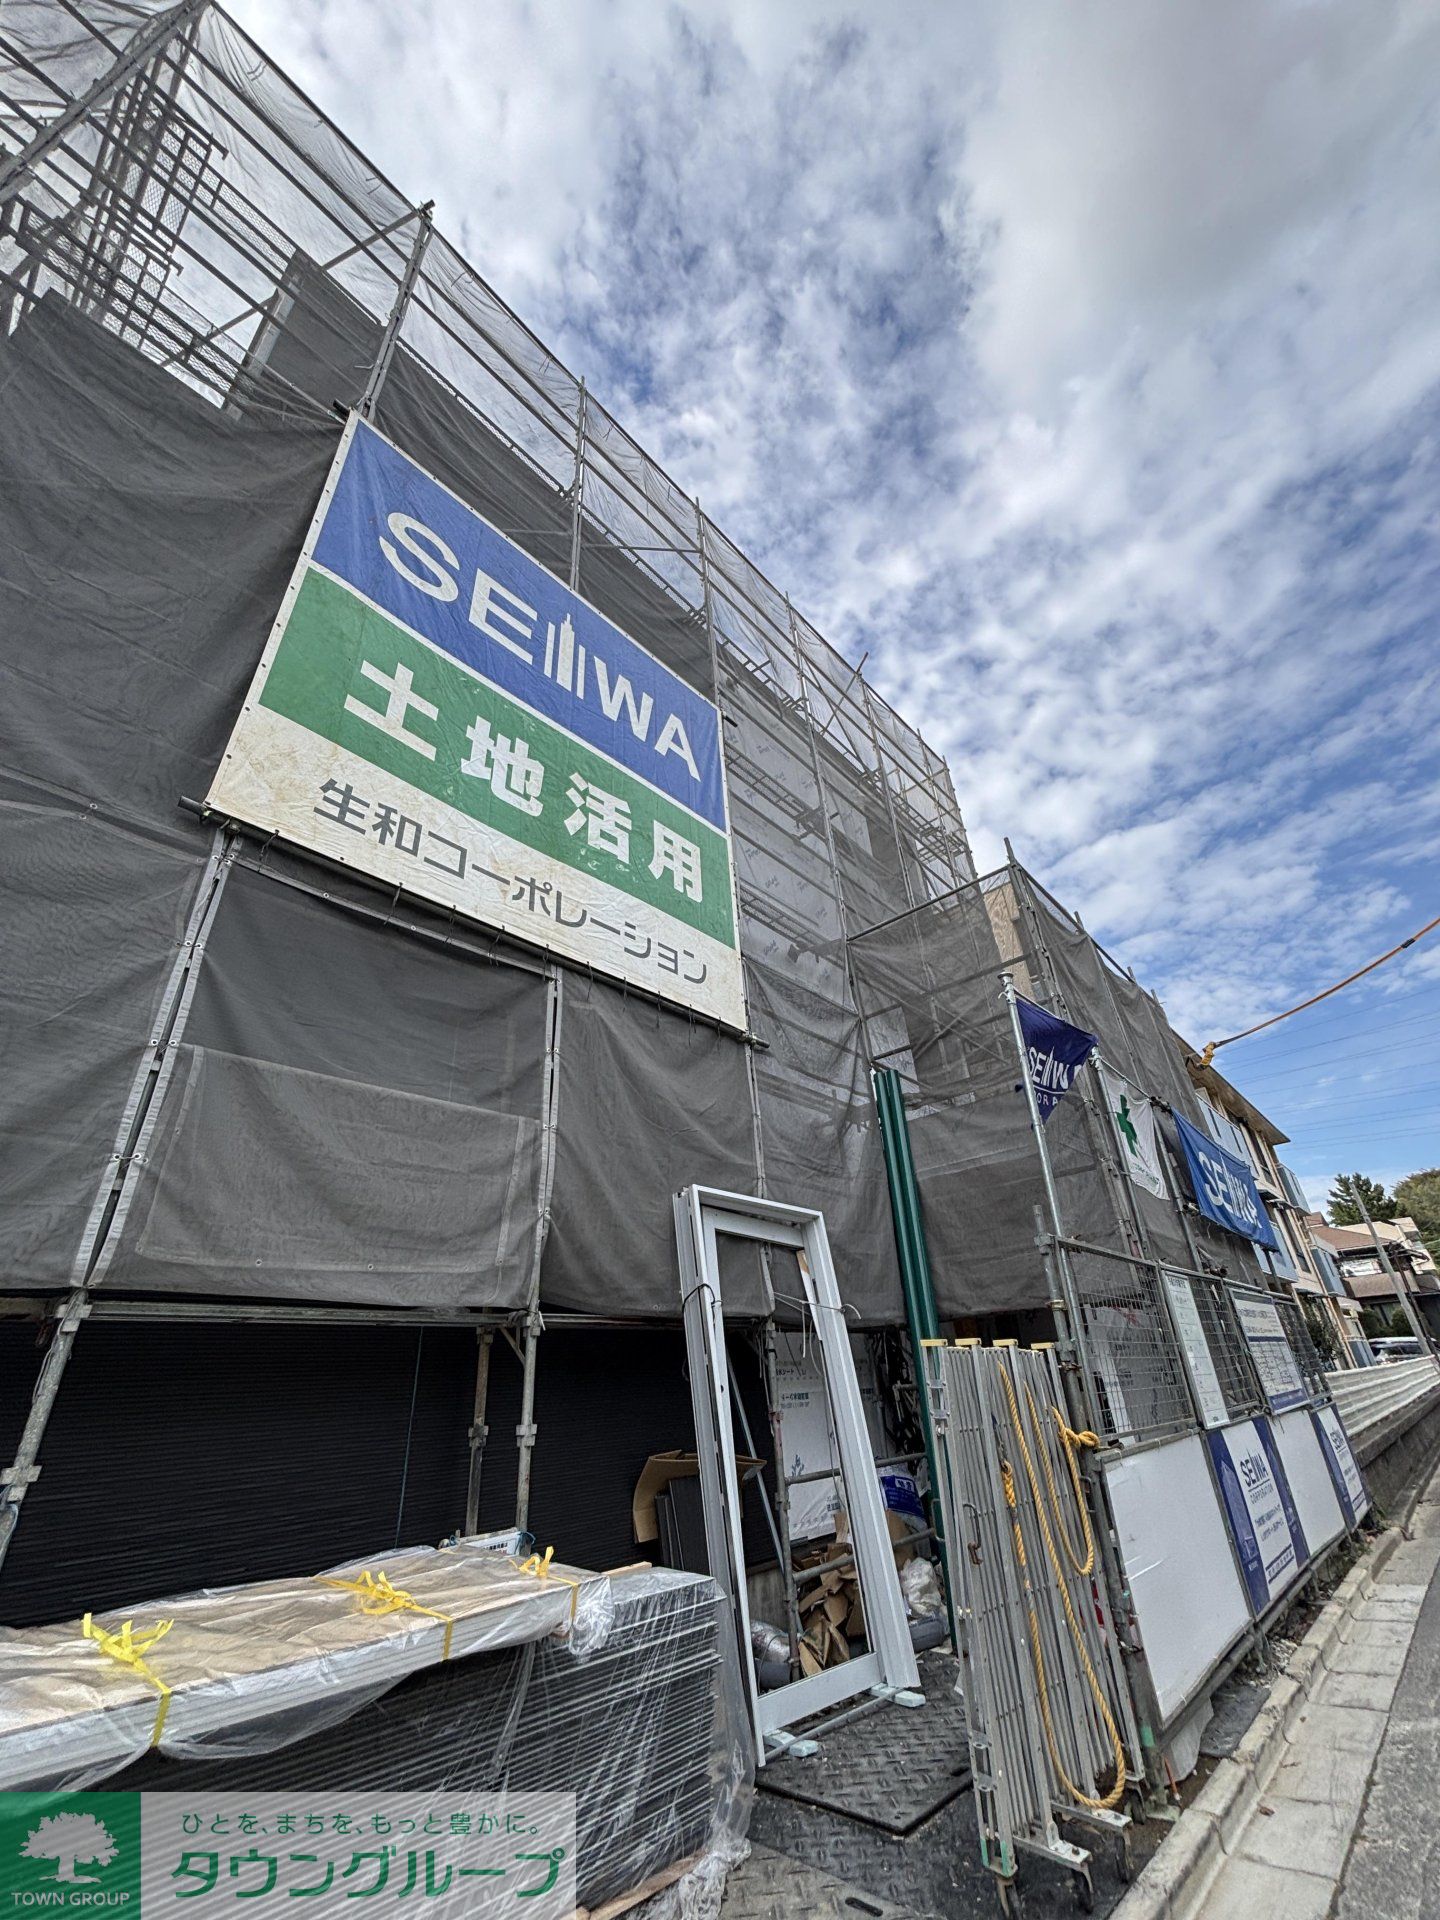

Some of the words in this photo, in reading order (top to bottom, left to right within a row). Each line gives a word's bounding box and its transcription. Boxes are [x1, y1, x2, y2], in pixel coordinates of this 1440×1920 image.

[378, 511, 701, 782] SEIWA
[313, 777, 707, 984] 生和コーポレーション
[344, 660, 703, 903] 土地活用
